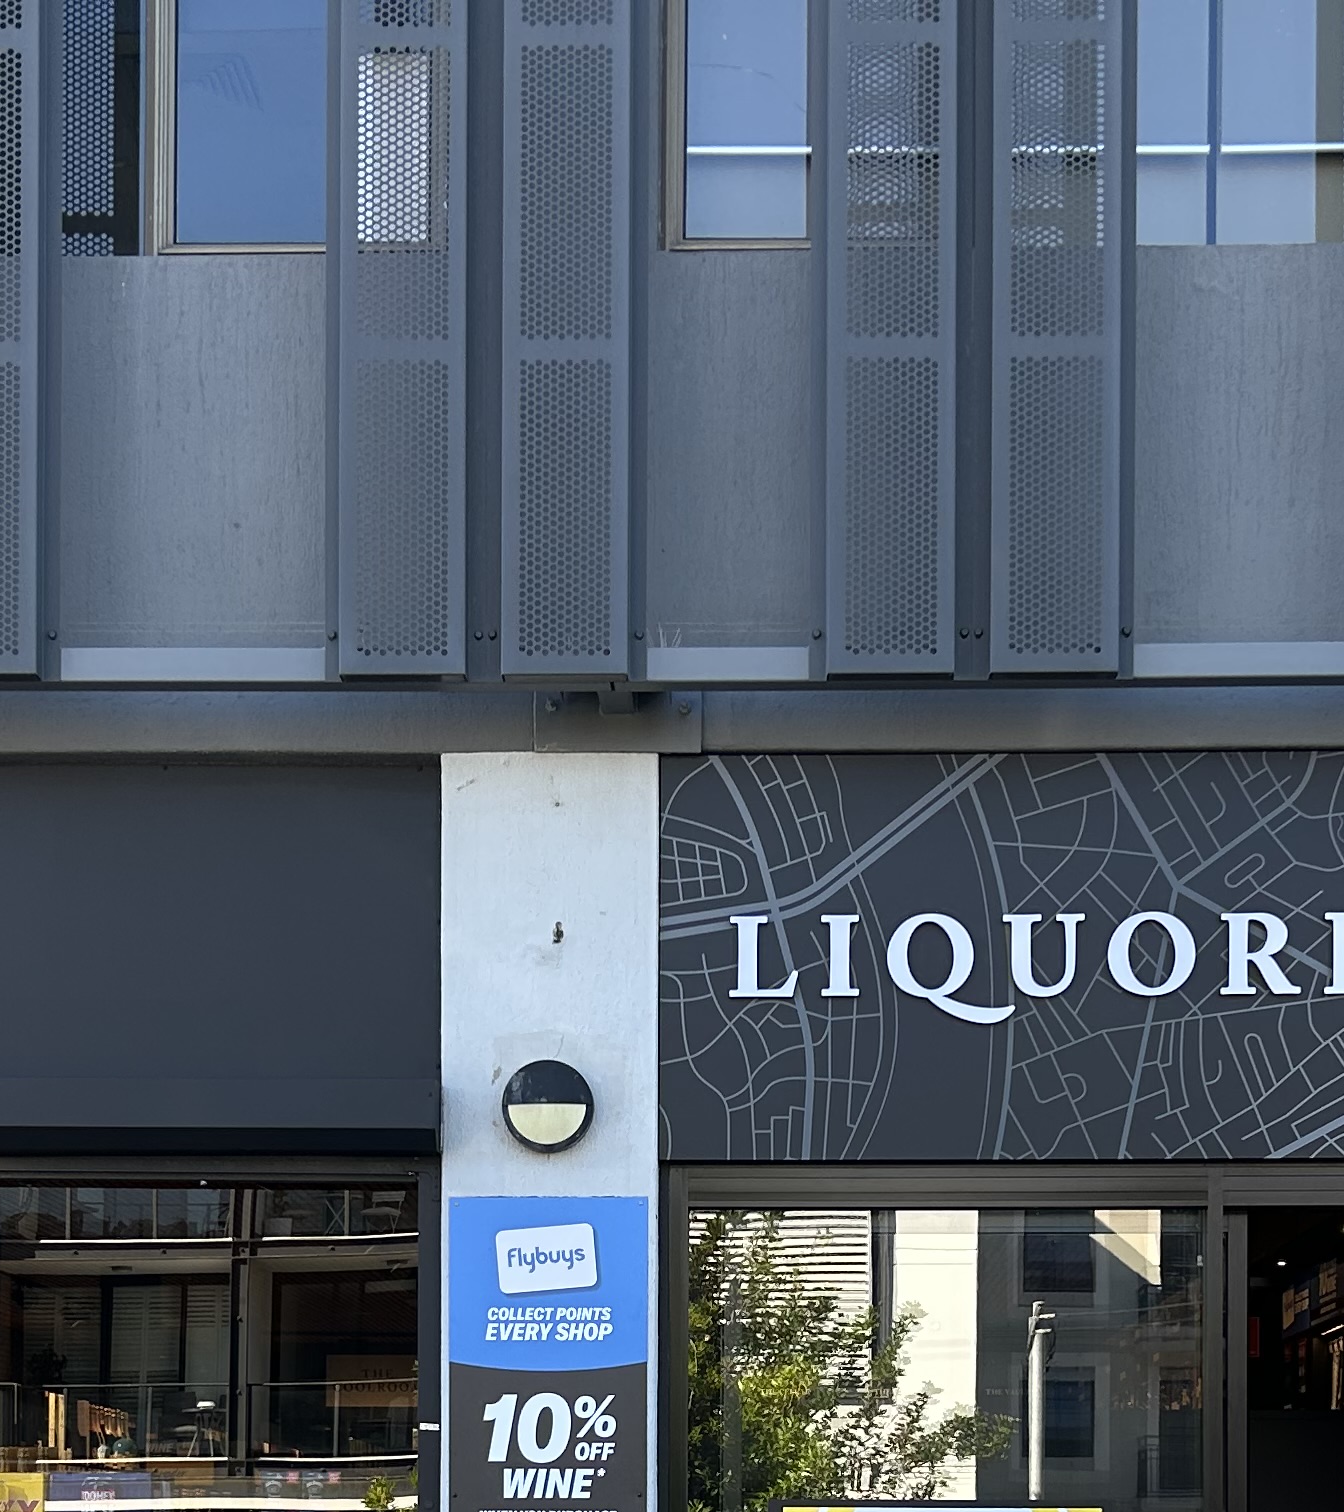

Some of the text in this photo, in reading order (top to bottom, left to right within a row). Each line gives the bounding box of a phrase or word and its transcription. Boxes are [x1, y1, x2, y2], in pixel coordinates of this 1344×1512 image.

[507, 1247, 585, 1273] flybuys
[487, 1307, 611, 1321] COLLECT POINTS
[485, 1323, 613, 1341] EVERY SHOP
[574, 1442, 616, 1461] OFF
